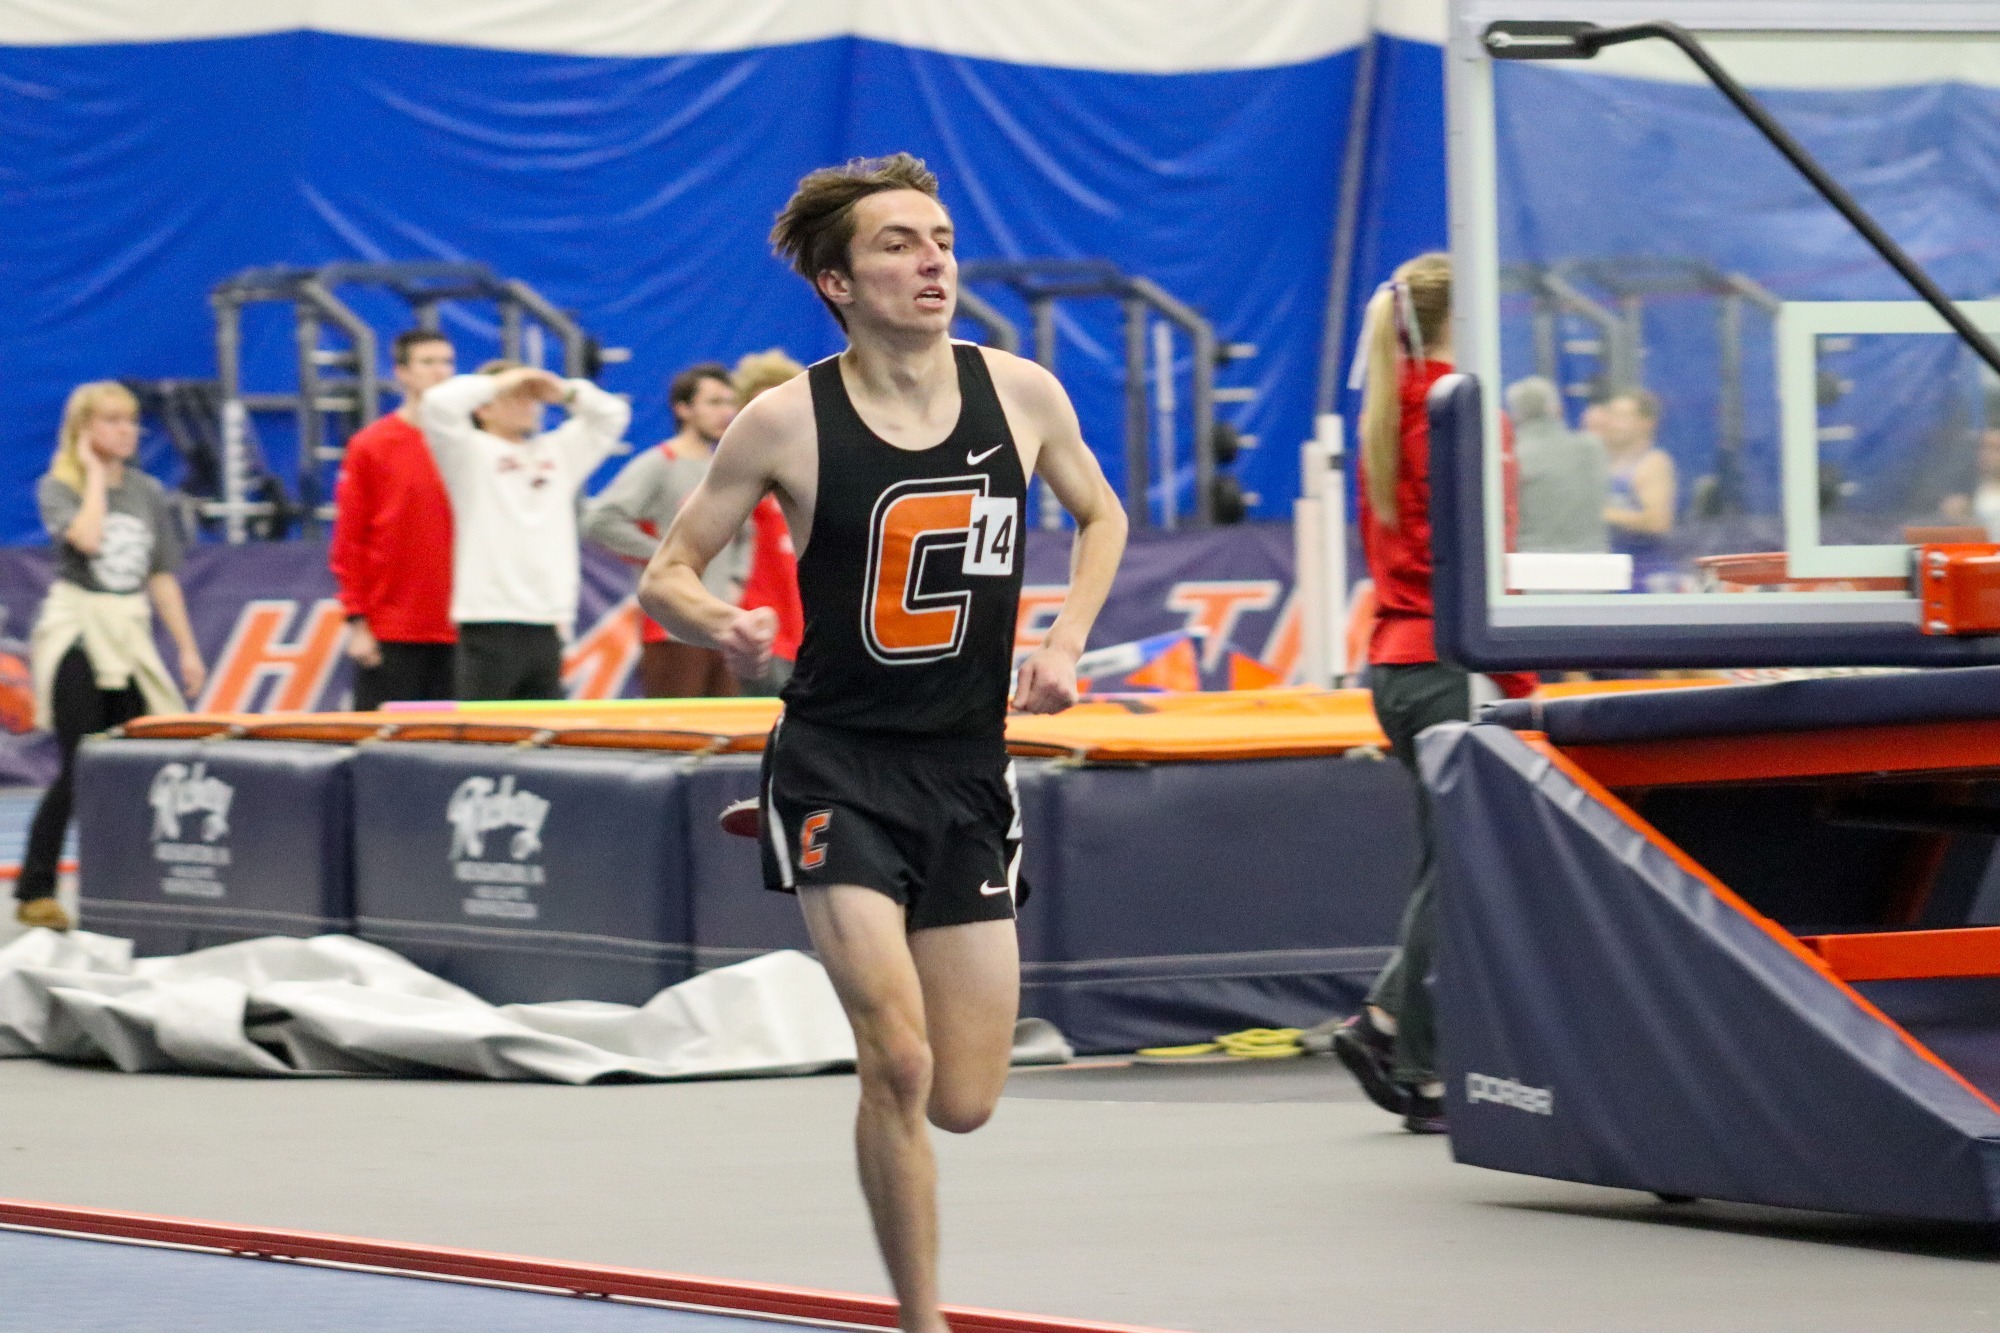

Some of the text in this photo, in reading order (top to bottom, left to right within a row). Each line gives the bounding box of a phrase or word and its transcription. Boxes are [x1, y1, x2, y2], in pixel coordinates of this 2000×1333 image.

[860, 473, 990, 665] C
[972, 513, 1013, 565] 14
[800, 808, 834, 871] C
